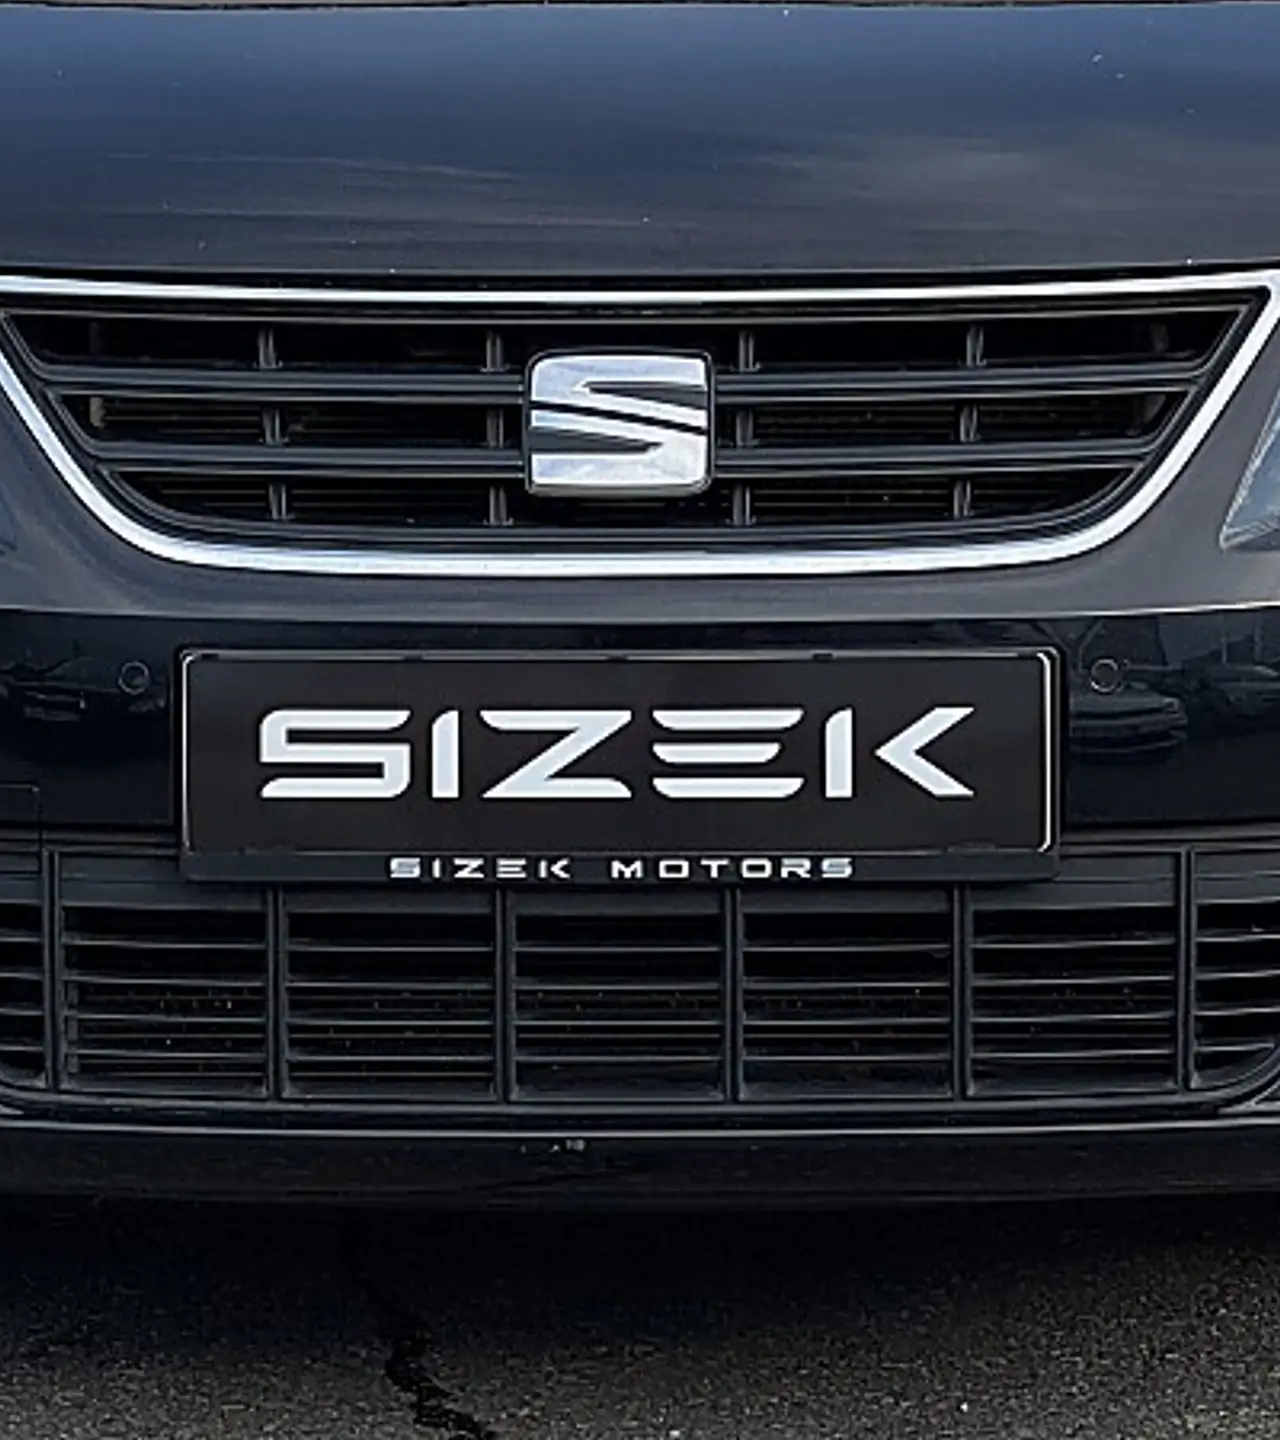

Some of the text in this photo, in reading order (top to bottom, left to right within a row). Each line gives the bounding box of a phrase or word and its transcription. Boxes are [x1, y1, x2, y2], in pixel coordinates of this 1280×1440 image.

[259, 707, 975, 798] SIZEK
[389, 857, 853, 880] SIZEK MOTORS
